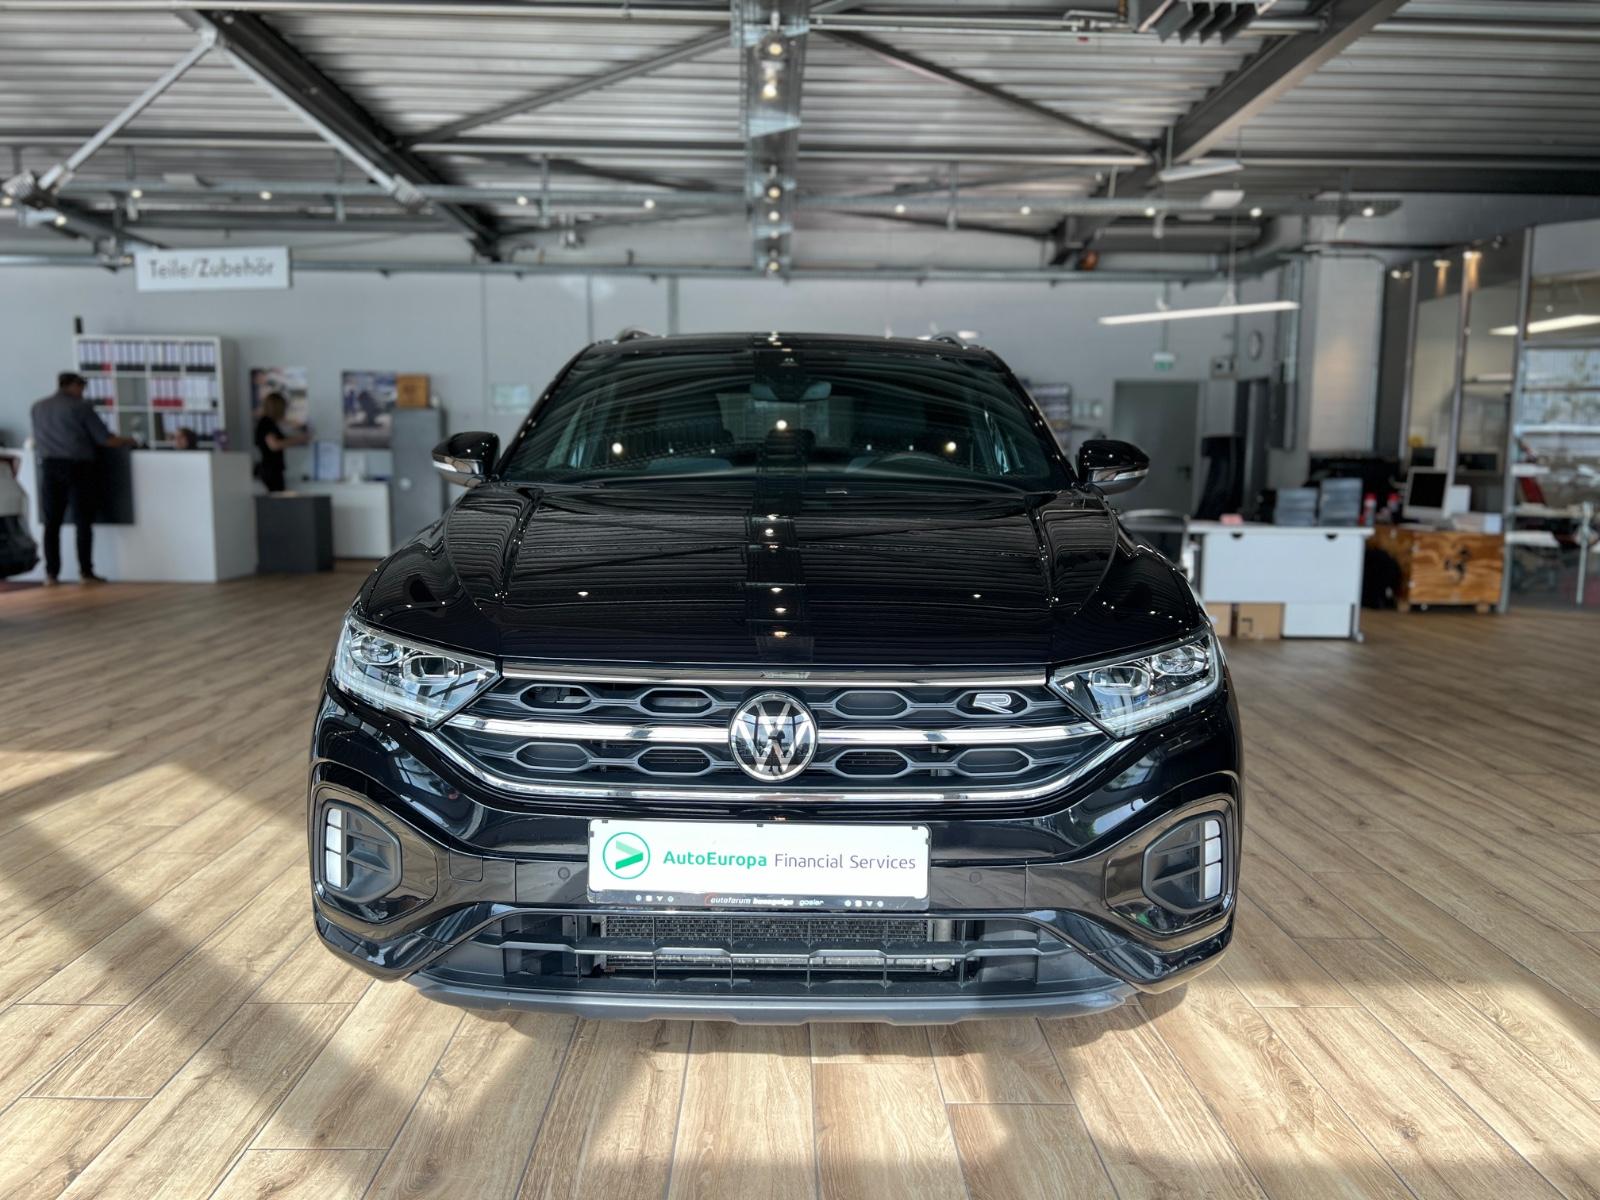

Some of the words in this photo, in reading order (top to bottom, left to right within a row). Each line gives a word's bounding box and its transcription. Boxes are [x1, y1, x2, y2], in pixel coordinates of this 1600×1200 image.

[149, 256, 275, 278] Teile/Zubehör
[973, 693, 1013, 714] R
[730, 694, 817, 780] VW
[663, 851, 768, 869] AutoEuropa
[775, 853, 844, 869] Financial
[849, 855, 917, 869] Services
